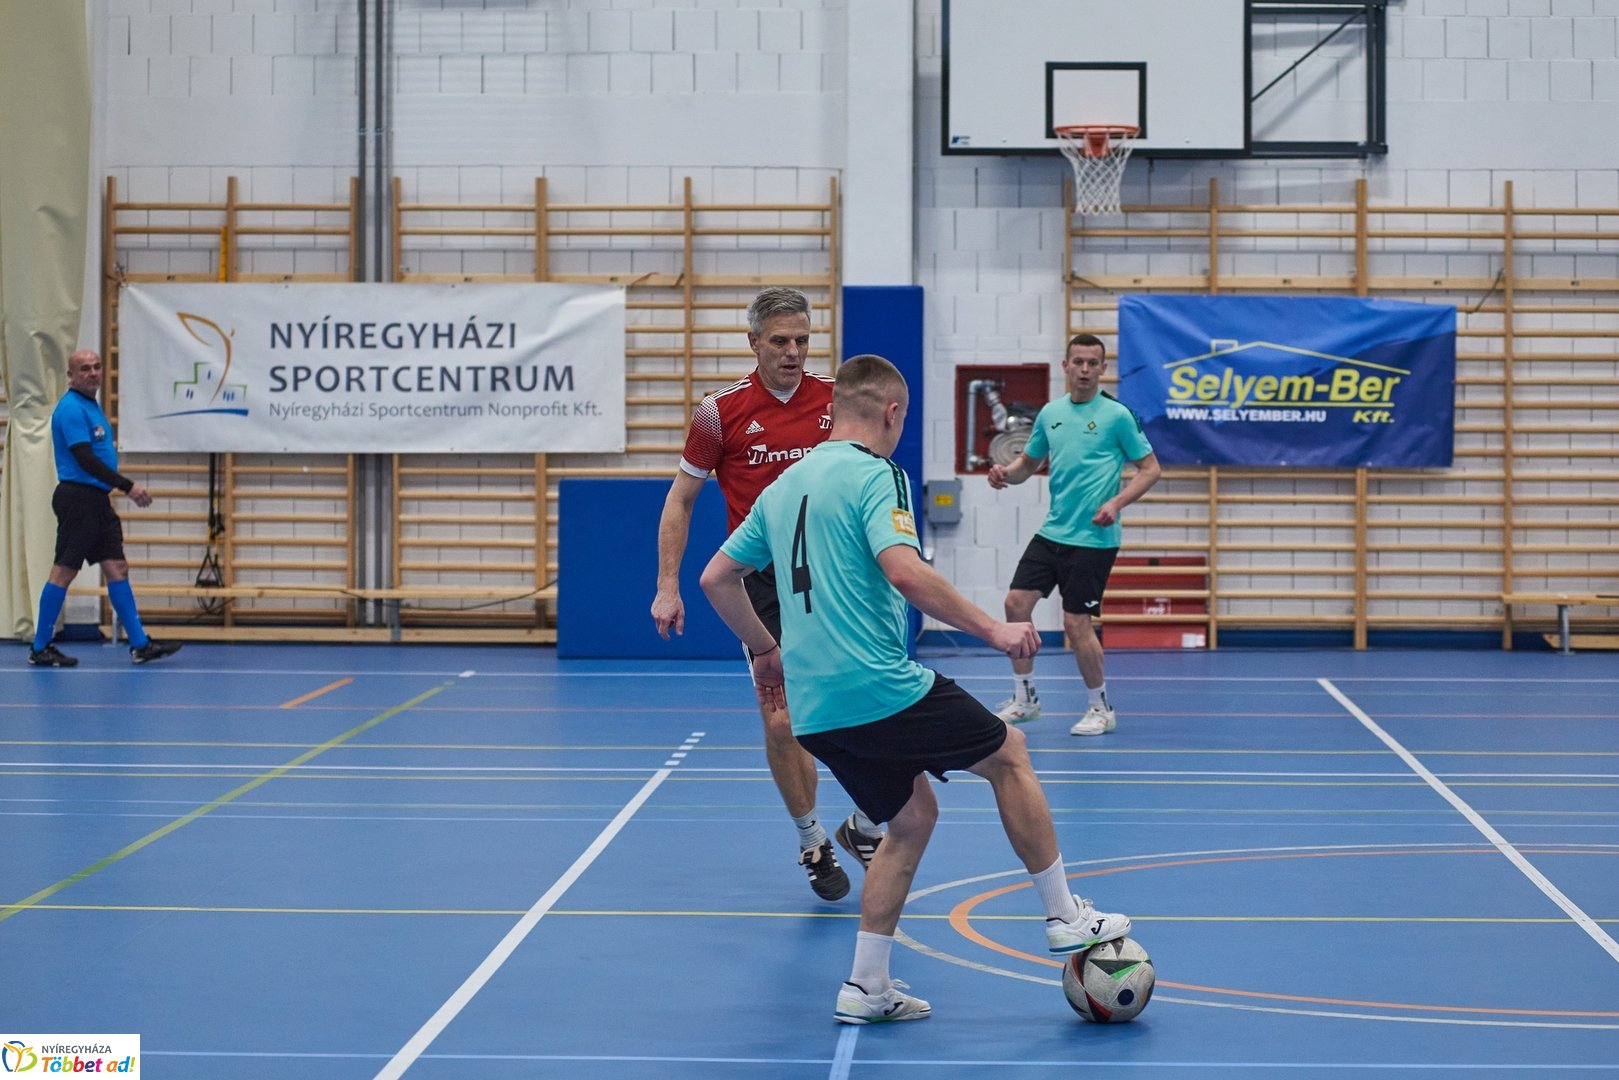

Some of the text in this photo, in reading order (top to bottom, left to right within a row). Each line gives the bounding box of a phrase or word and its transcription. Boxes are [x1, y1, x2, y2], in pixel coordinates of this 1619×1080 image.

[269, 316, 517, 350] NYÍREGYHÁZI
[269, 365, 575, 393] SPORTCENTRUM
[1168, 366, 1400, 408] Selyem-Ber
[268, 401, 603, 420] Nyíregyházi Sportcentrum Nonprofit Kft.
[1166, 407, 1327, 422] WWW.SELYEMBER.HU
[1352, 410, 1395, 423] Kft.
[791, 494, 813, 614] 4
